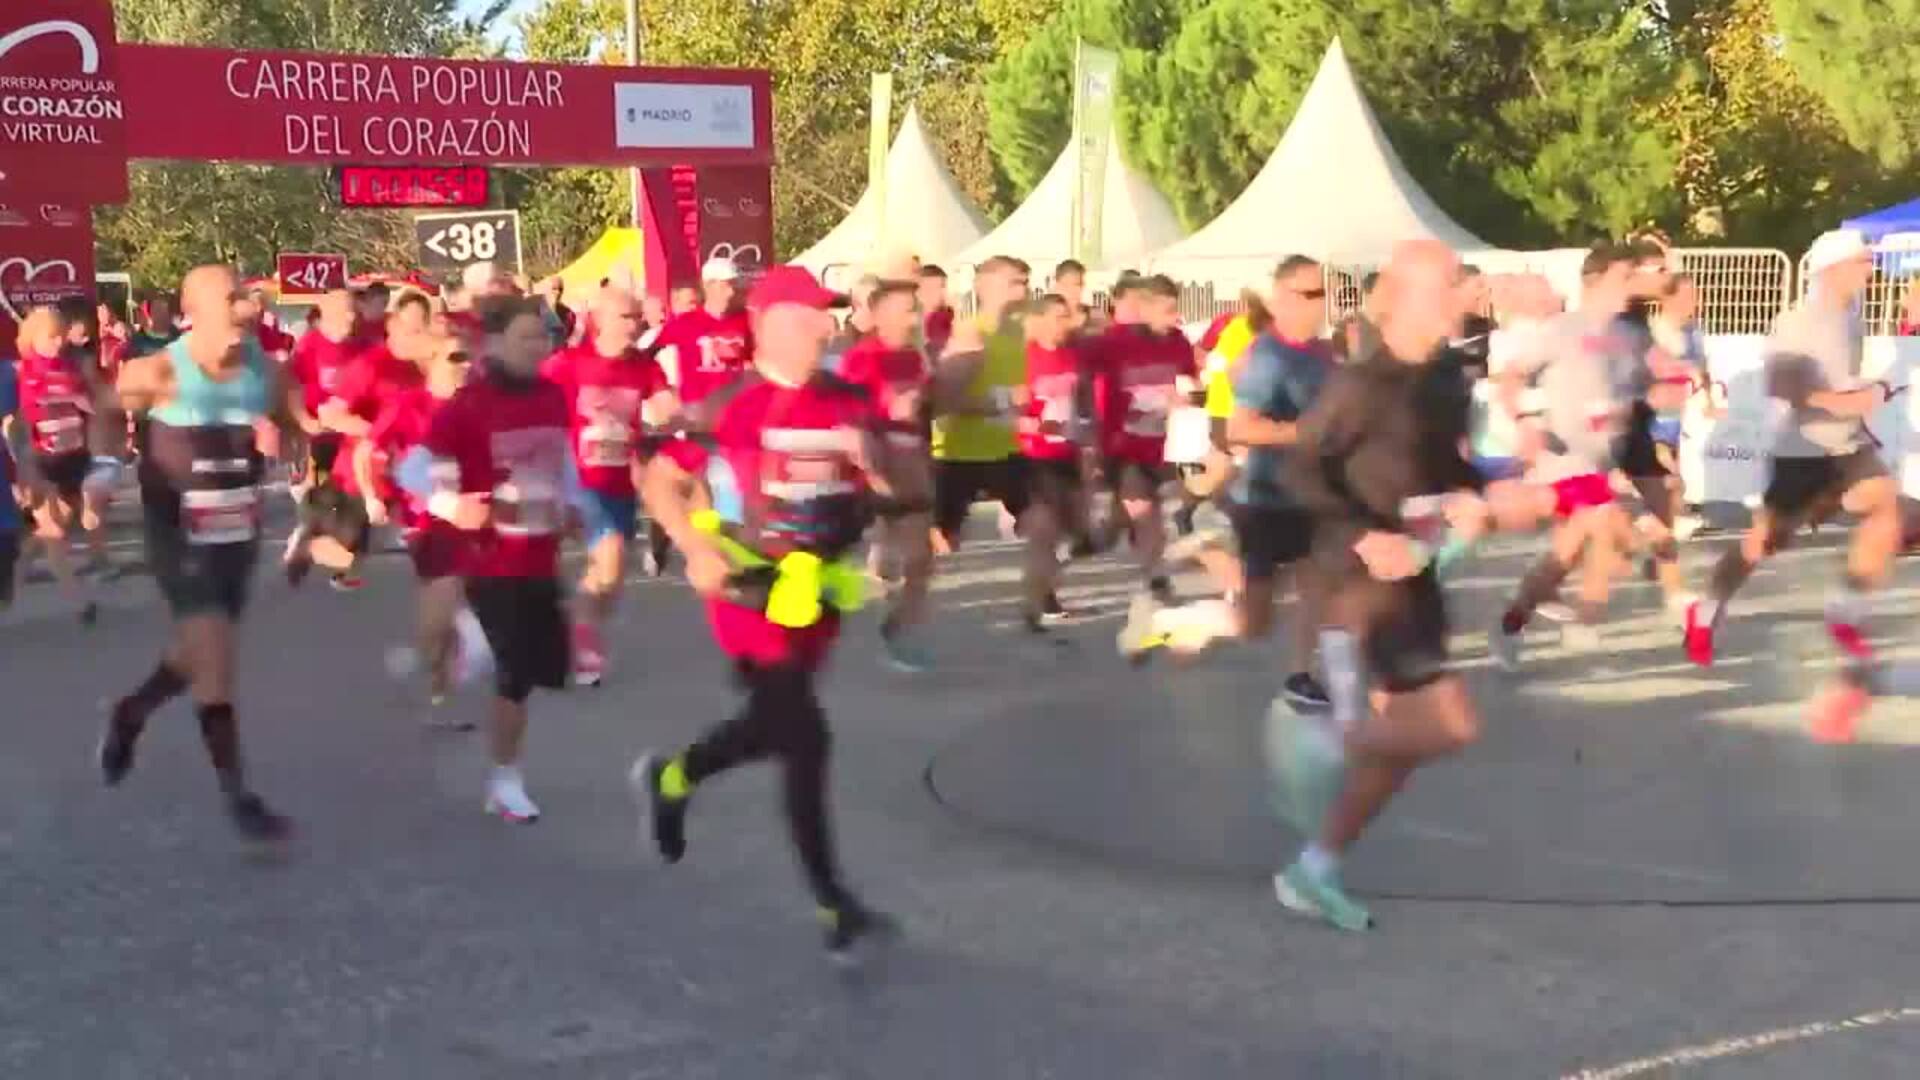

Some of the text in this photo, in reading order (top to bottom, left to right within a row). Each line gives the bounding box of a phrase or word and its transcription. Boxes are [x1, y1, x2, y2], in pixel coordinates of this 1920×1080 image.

[0, 76, 116, 93] RRERA POPULAR
[226, 58, 564, 107] CARRERA POPULAR
[2, 94, 123, 119] CORAZÓN
[3, 122, 103, 144] VIRTUAL
[285, 111, 530, 156] DEL CORAZÓN
